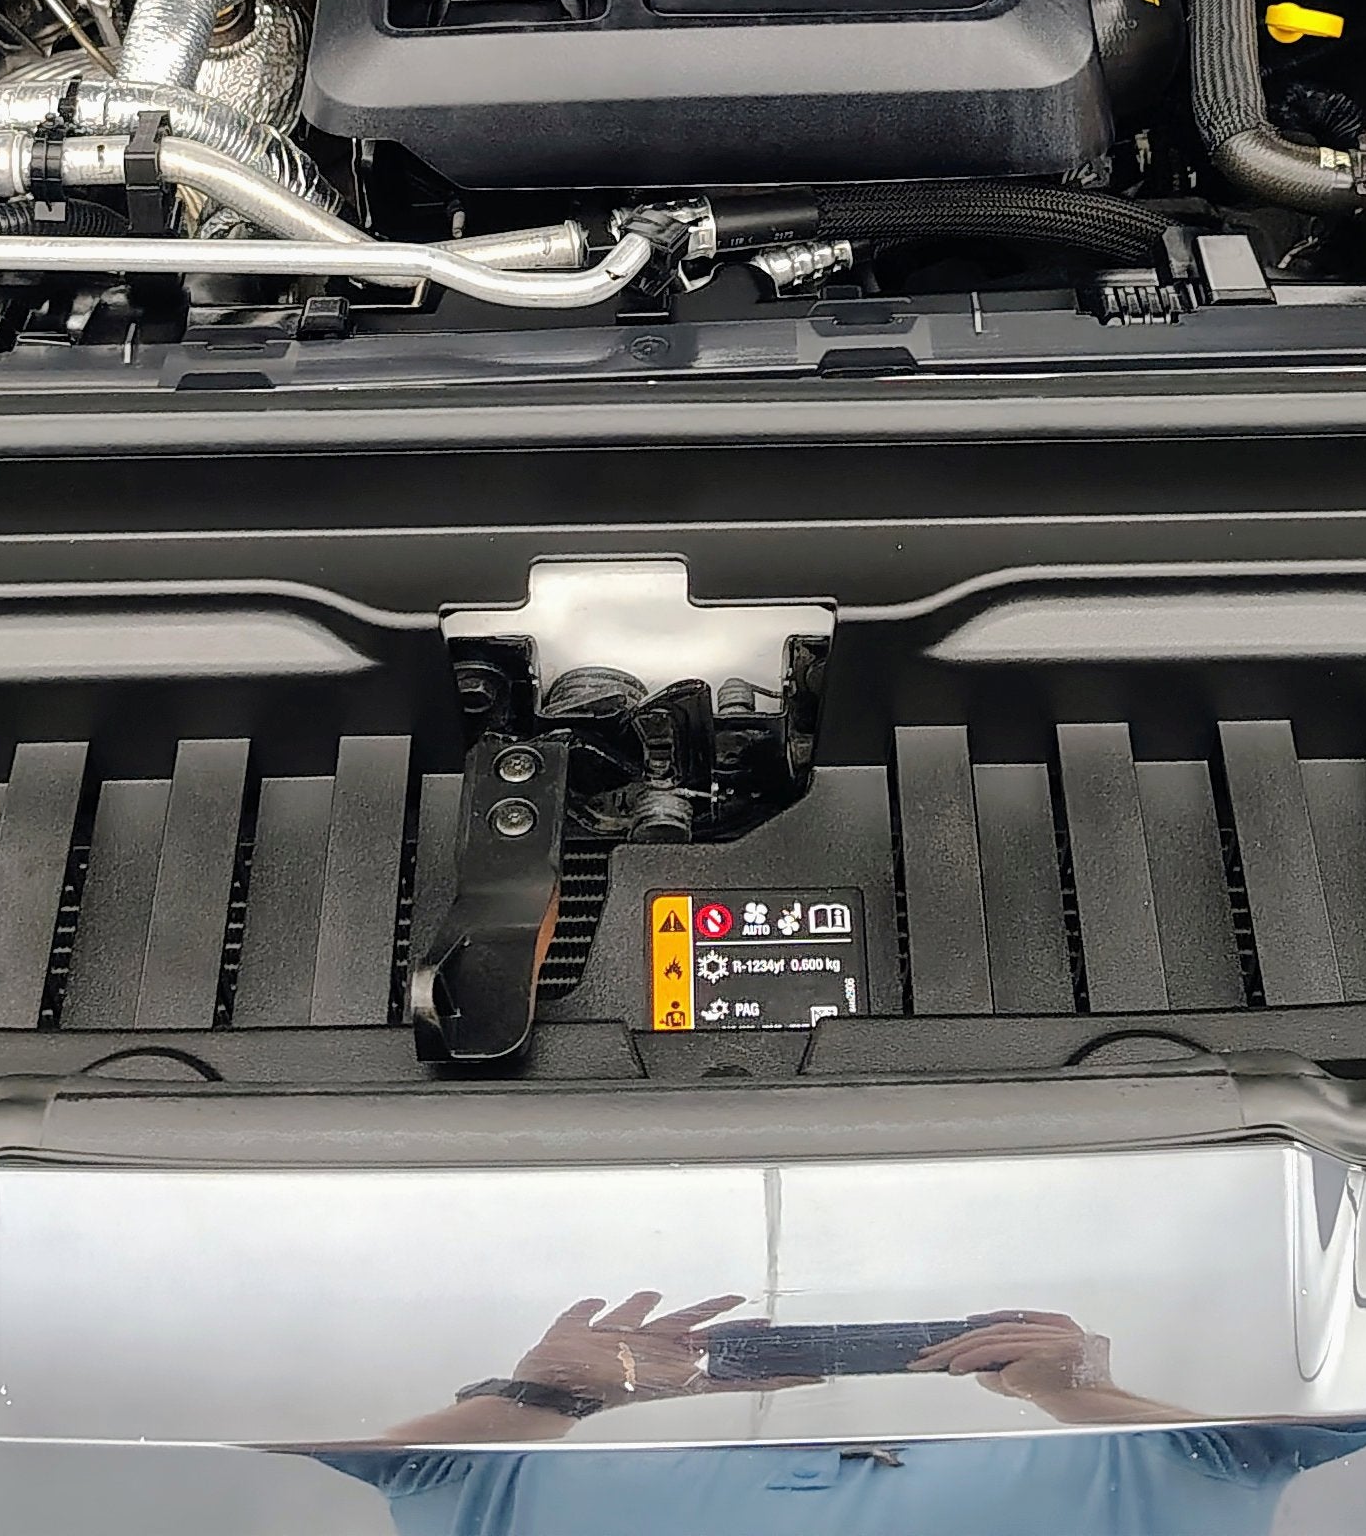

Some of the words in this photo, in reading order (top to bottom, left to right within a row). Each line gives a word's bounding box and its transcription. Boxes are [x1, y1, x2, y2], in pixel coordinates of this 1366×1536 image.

[742, 924, 771, 936] AUTO
[731, 958, 785, 975] R-1234yf
[825, 957, 841, 972] kg
[735, 1002, 760, 1017] PAG
